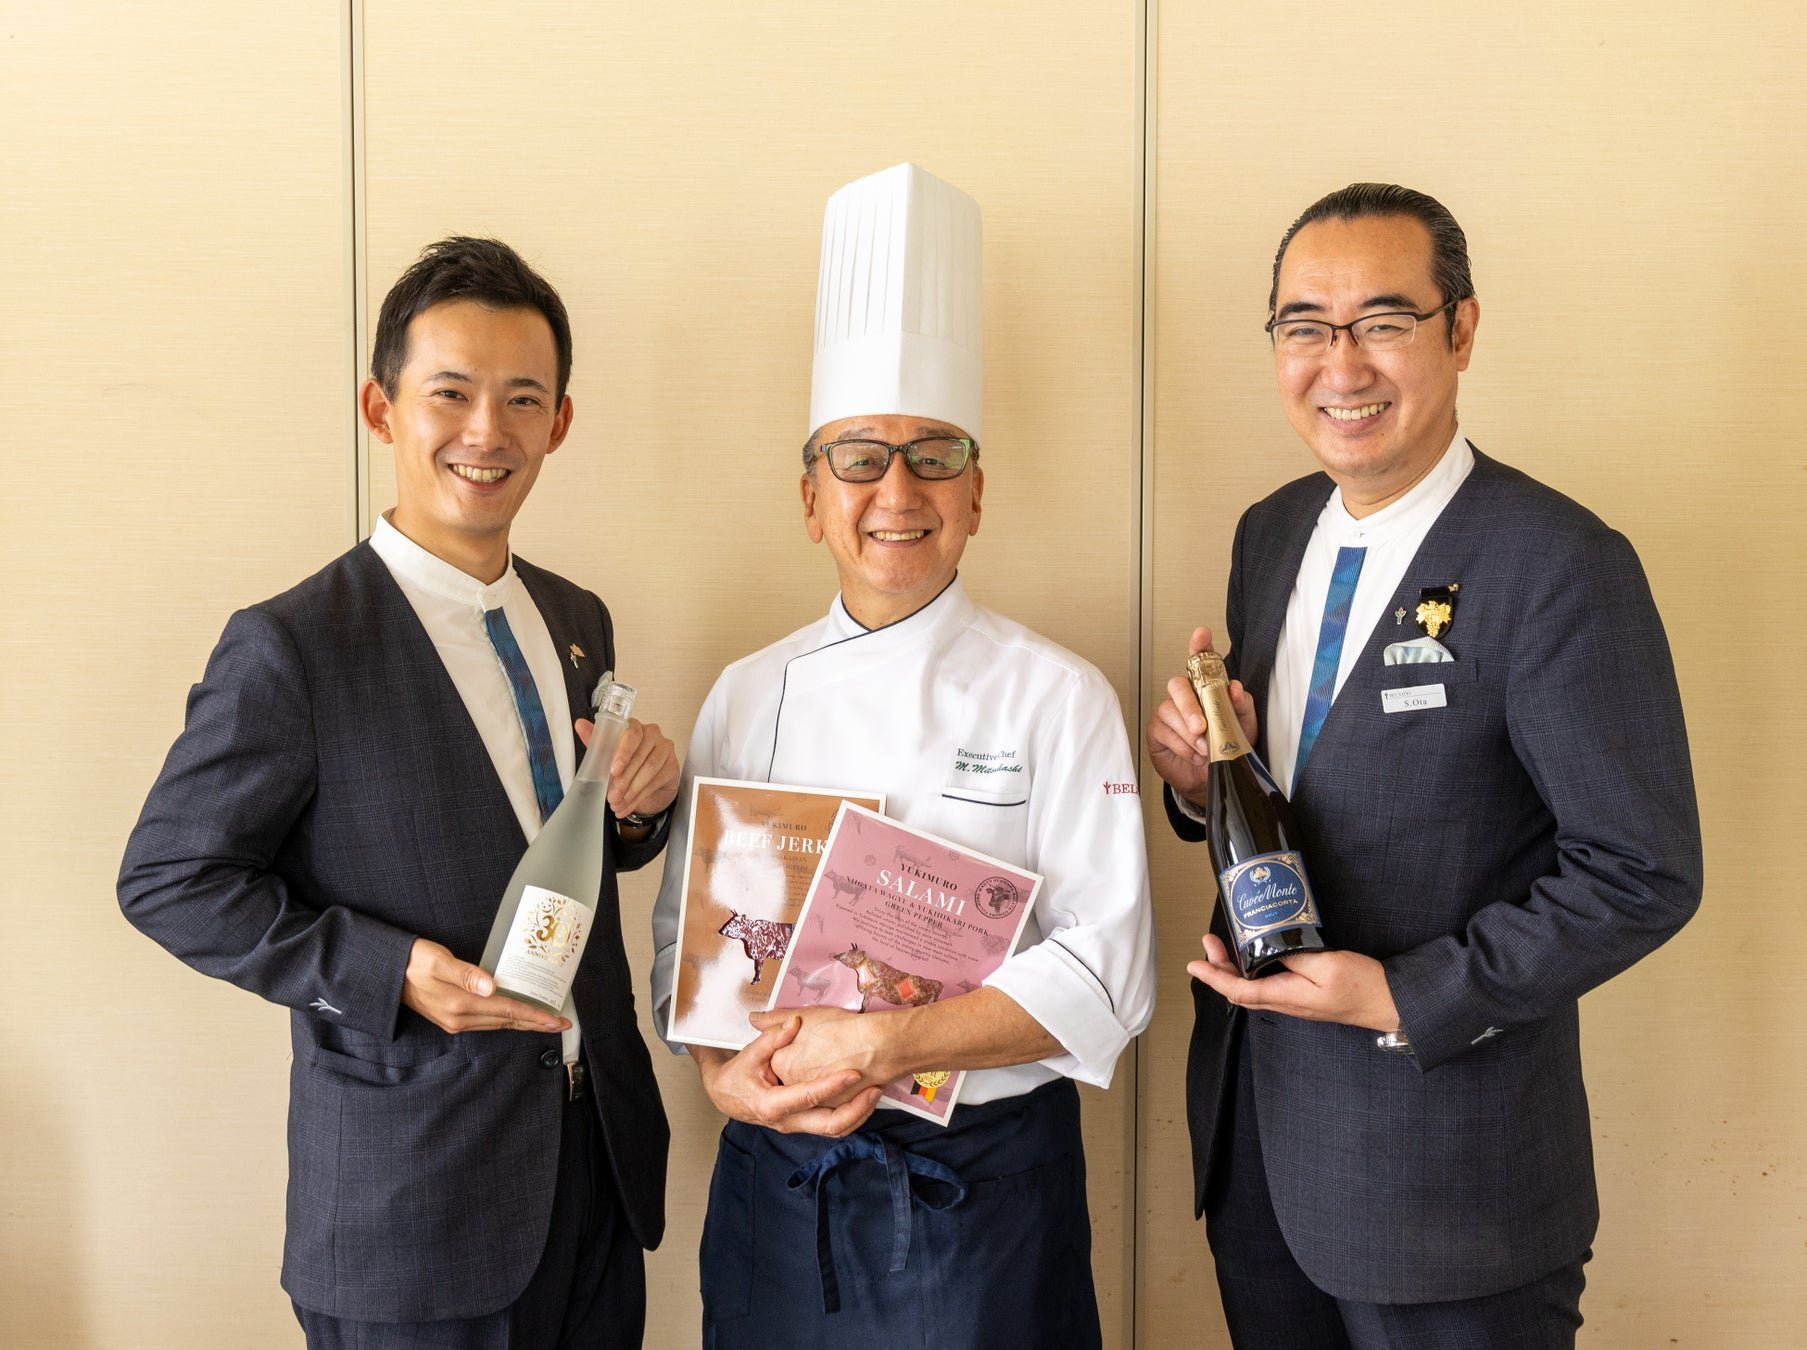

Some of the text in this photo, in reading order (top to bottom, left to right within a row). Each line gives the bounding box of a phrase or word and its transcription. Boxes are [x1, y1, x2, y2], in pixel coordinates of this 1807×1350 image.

[957, 748, 996, 760] Executive
[955, 761, 970, 772] M.
[1112, 784, 1138, 794] BEL
[723, 829, 773, 849] BEEF
[899, 863, 958, 891] YUKIMURO
[875, 868, 966, 916] SALAMI
[1260, 883, 1297, 901] Monte
[878, 889, 908, 905] WAGYU
[966, 922, 990, 936] PORK
[884, 900, 912, 916] GREEN
[912, 911, 944, 928] PEPPER
[1243, 900, 1298, 919] FRANCIACORTA
